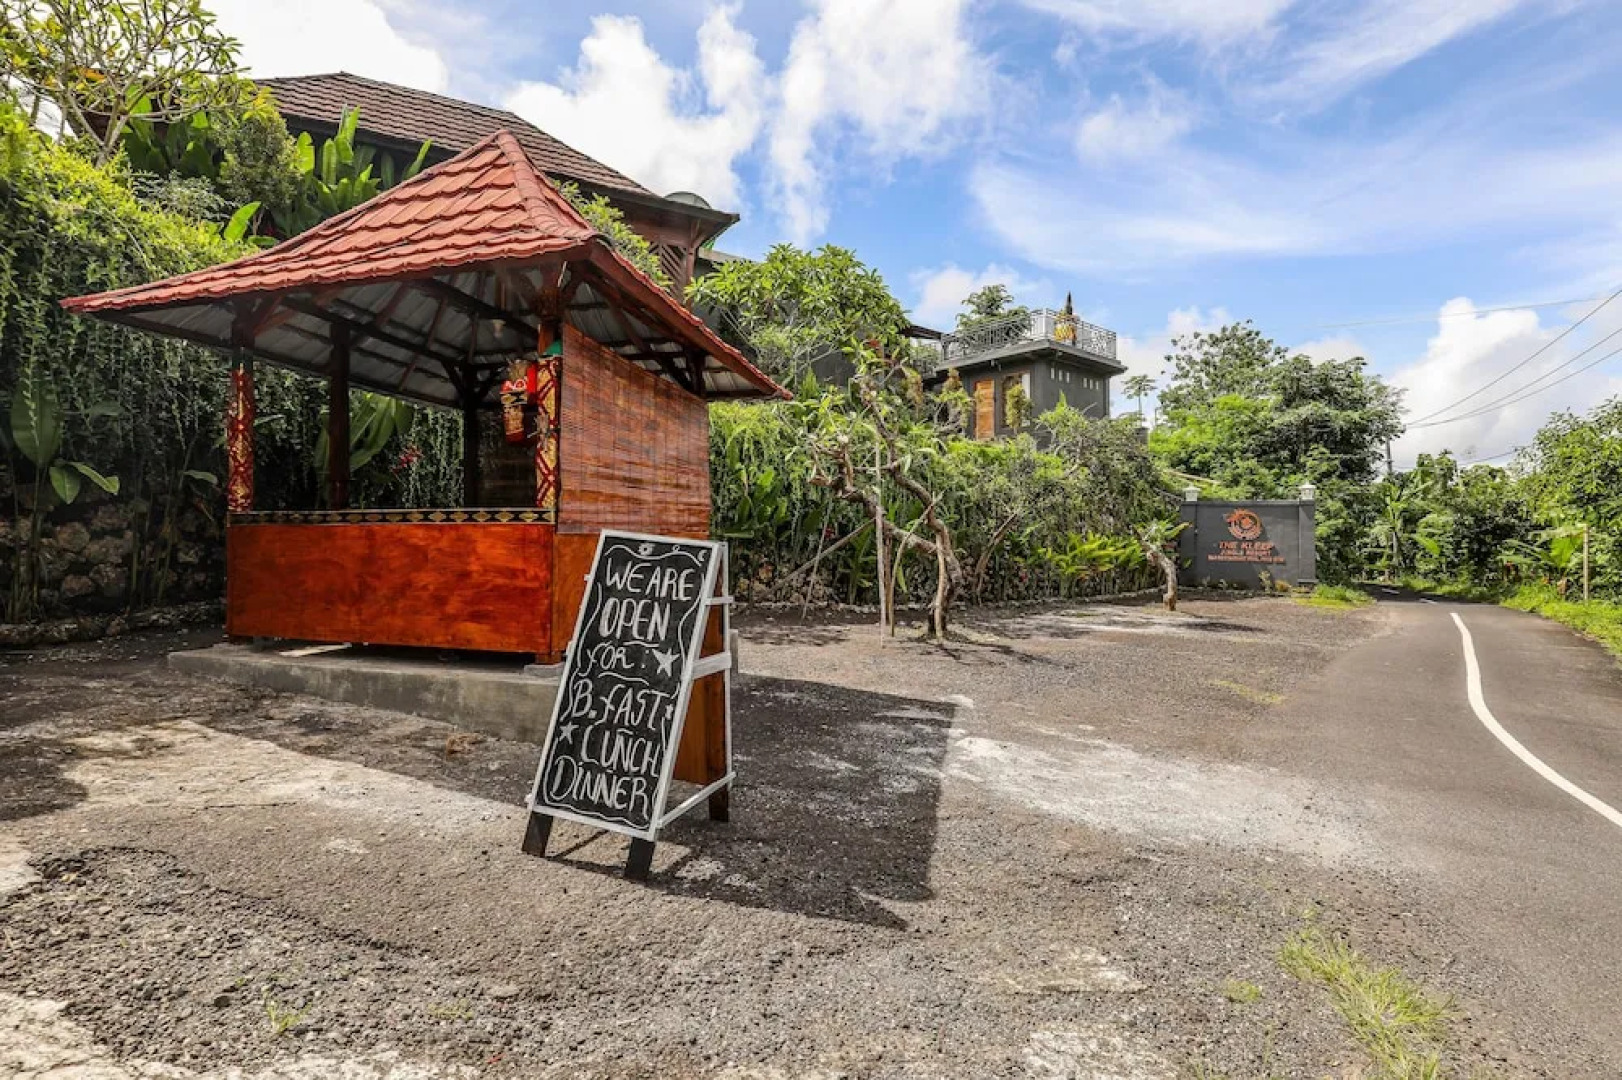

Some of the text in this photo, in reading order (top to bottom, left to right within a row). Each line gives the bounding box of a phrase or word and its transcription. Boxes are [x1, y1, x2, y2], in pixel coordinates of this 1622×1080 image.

[606, 558, 695, 601] WE ARE
[599, 597, 671, 641] OPEN
[581, 724, 660, 778] LUNCH
